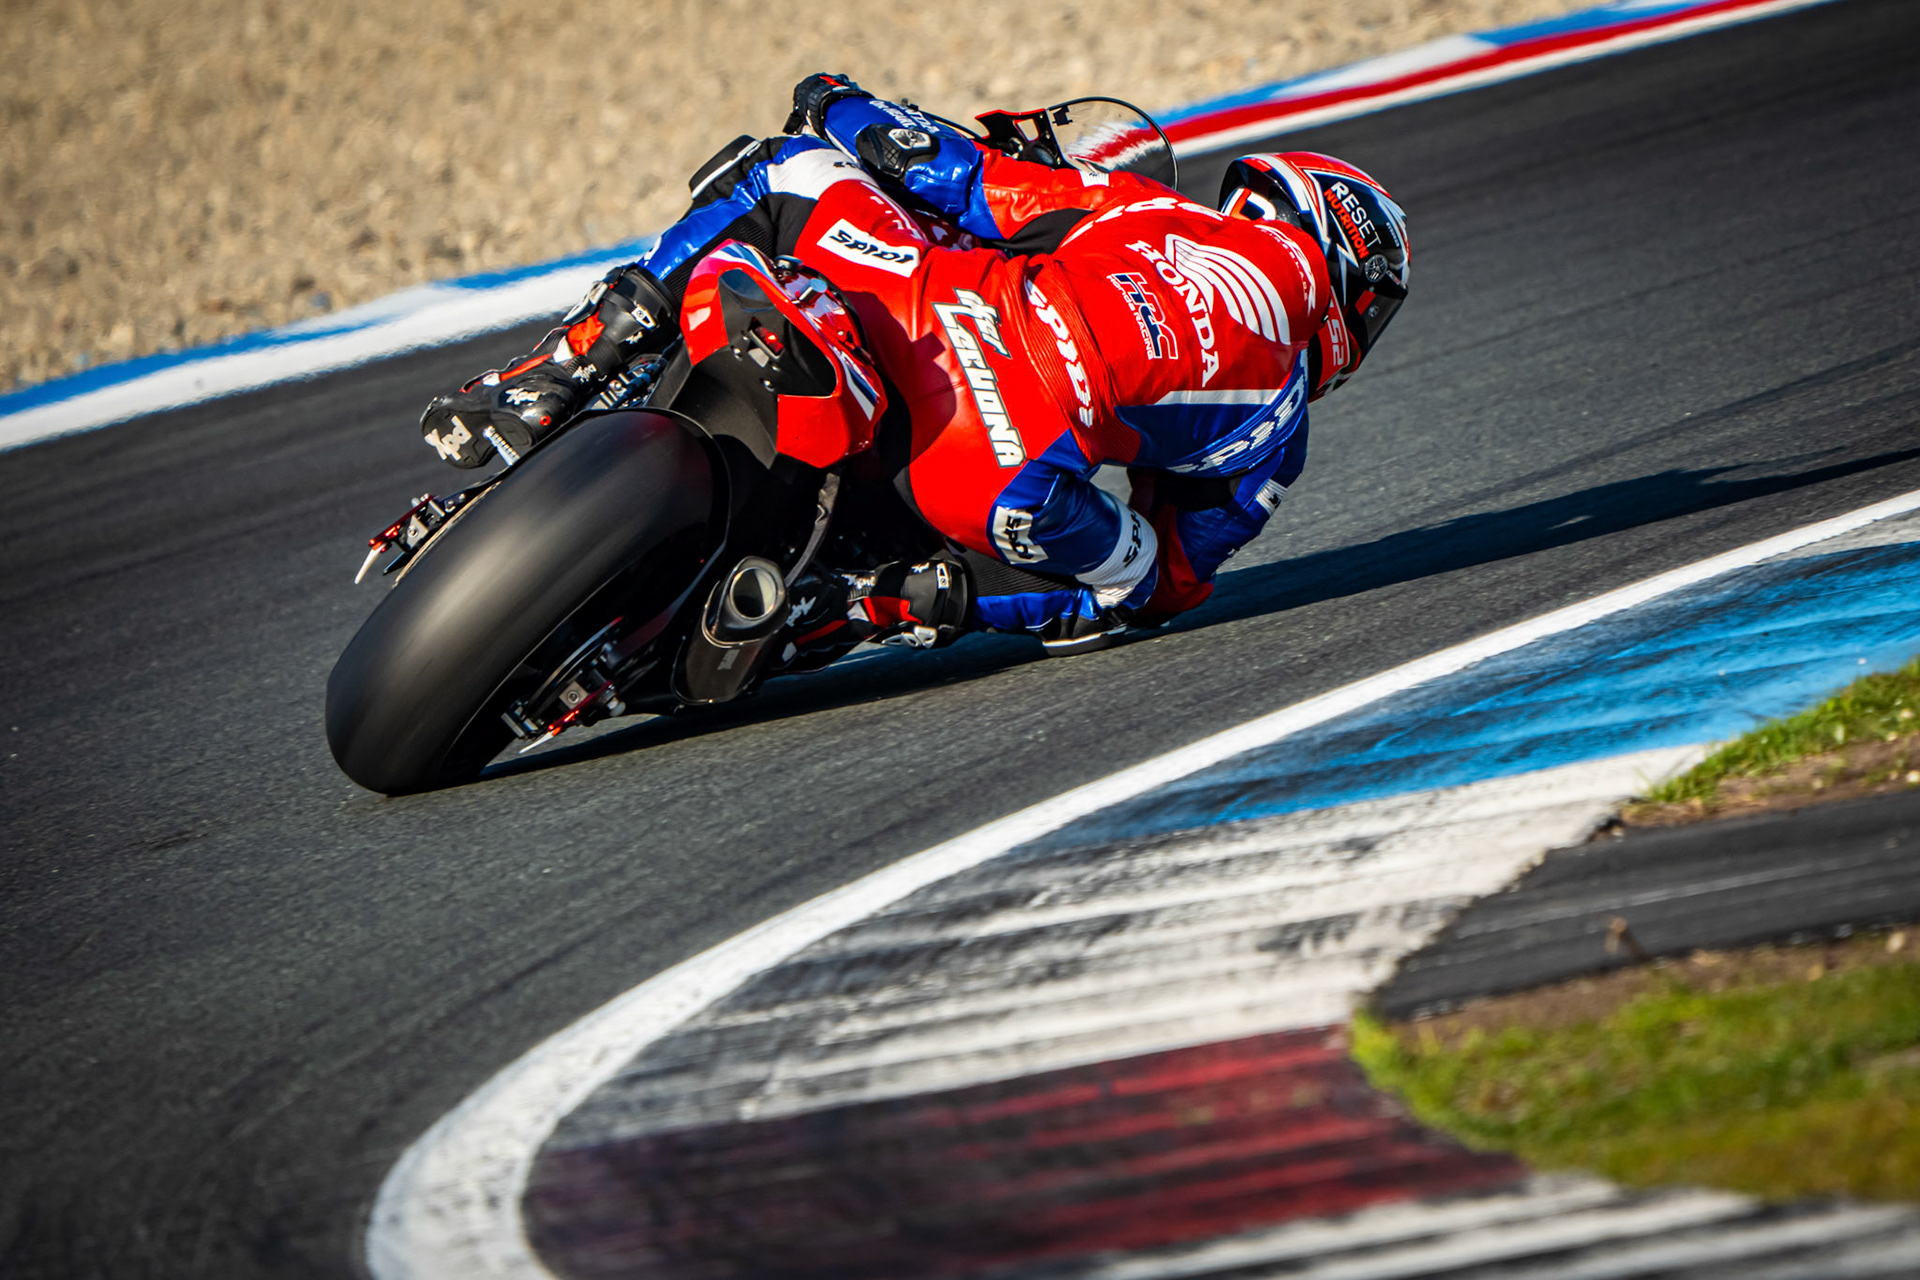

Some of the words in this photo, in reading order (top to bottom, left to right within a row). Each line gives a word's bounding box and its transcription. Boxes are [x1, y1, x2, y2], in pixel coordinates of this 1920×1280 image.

[828, 229, 915, 266] SPIDI
[1324, 188, 1370, 259] NUTRITION
[1330, 181, 1382, 246] RESET
[1112, 271, 1179, 361] HRC
[1125, 240, 1221, 388] HONDA
